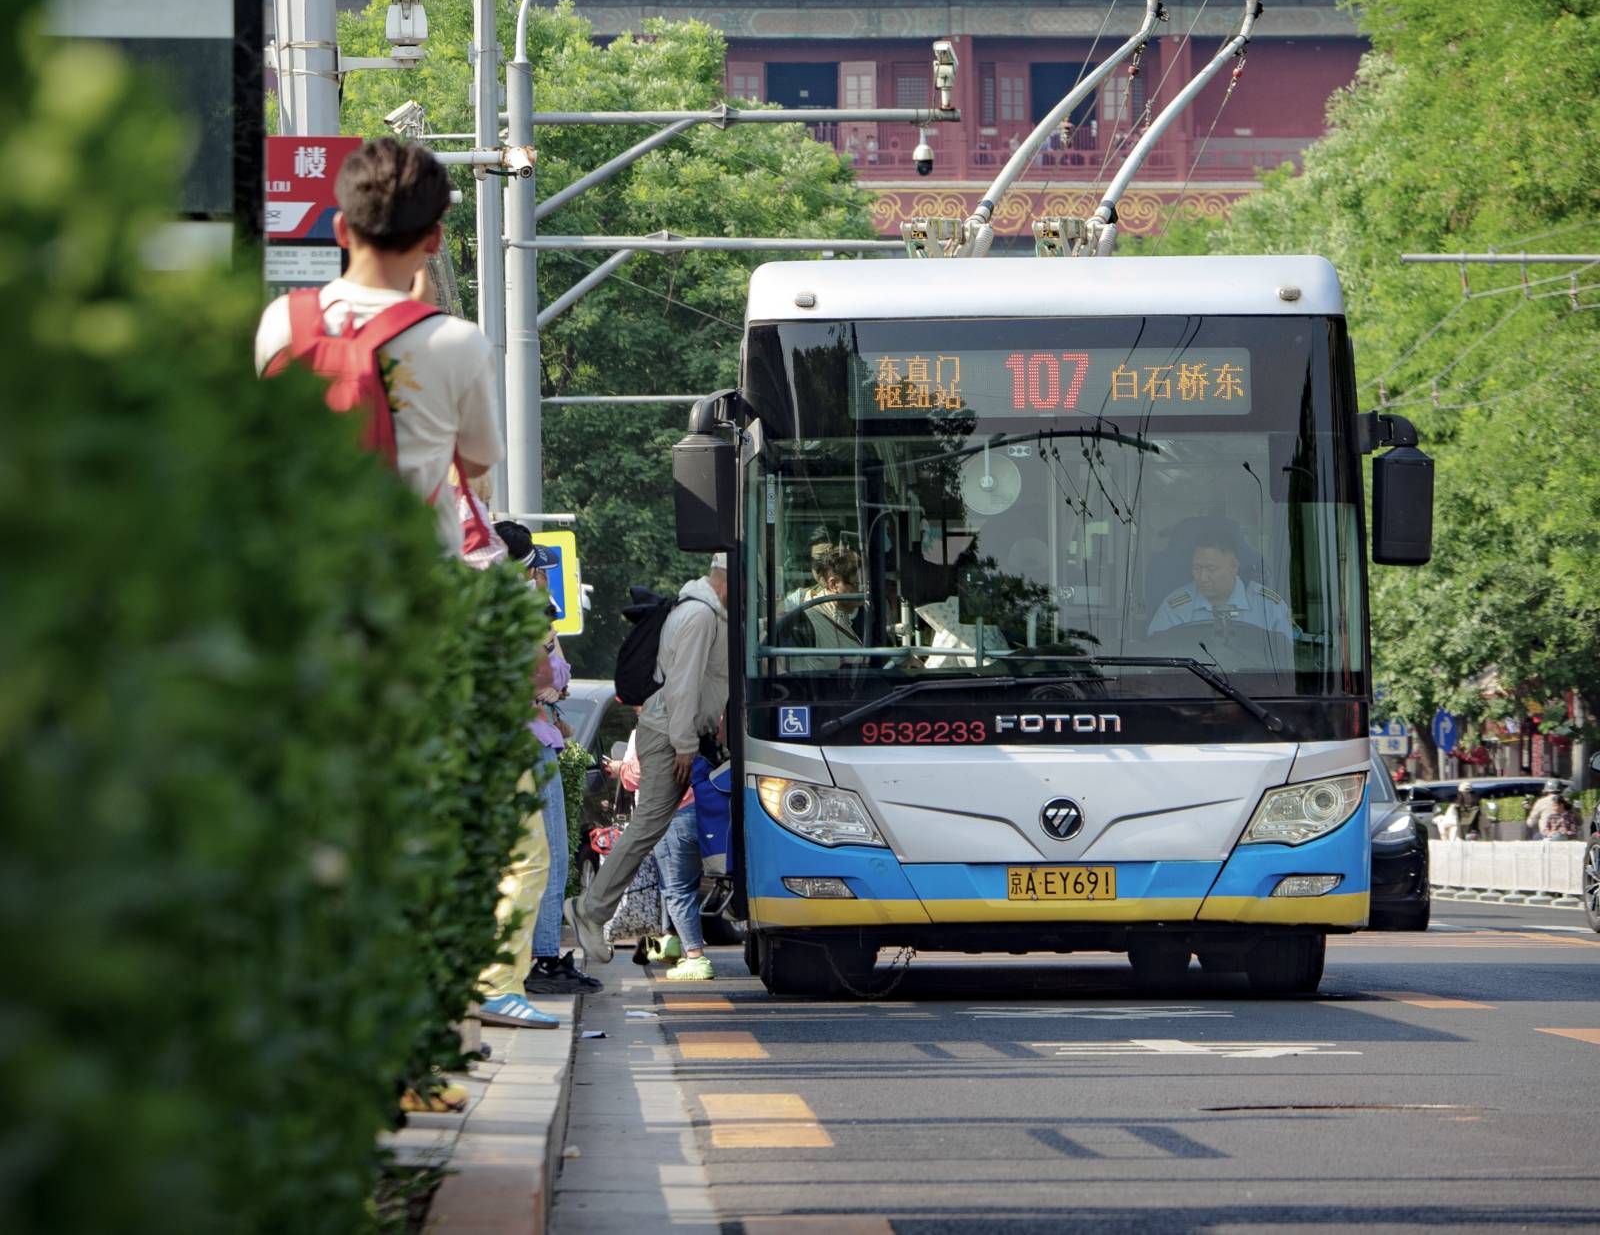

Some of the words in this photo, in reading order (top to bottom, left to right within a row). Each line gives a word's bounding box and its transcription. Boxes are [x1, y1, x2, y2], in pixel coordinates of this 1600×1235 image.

[294, 145, 327, 179] 楼
[875, 355, 961, 384] 东直门
[1004, 353, 1089, 410] 107
[1111, 363, 1244, 401] 白石桥东
[874, 382, 962, 411] 枢纽站
[862, 721, 987, 744] 9532233
[995, 714, 1121, 734] FOTON
